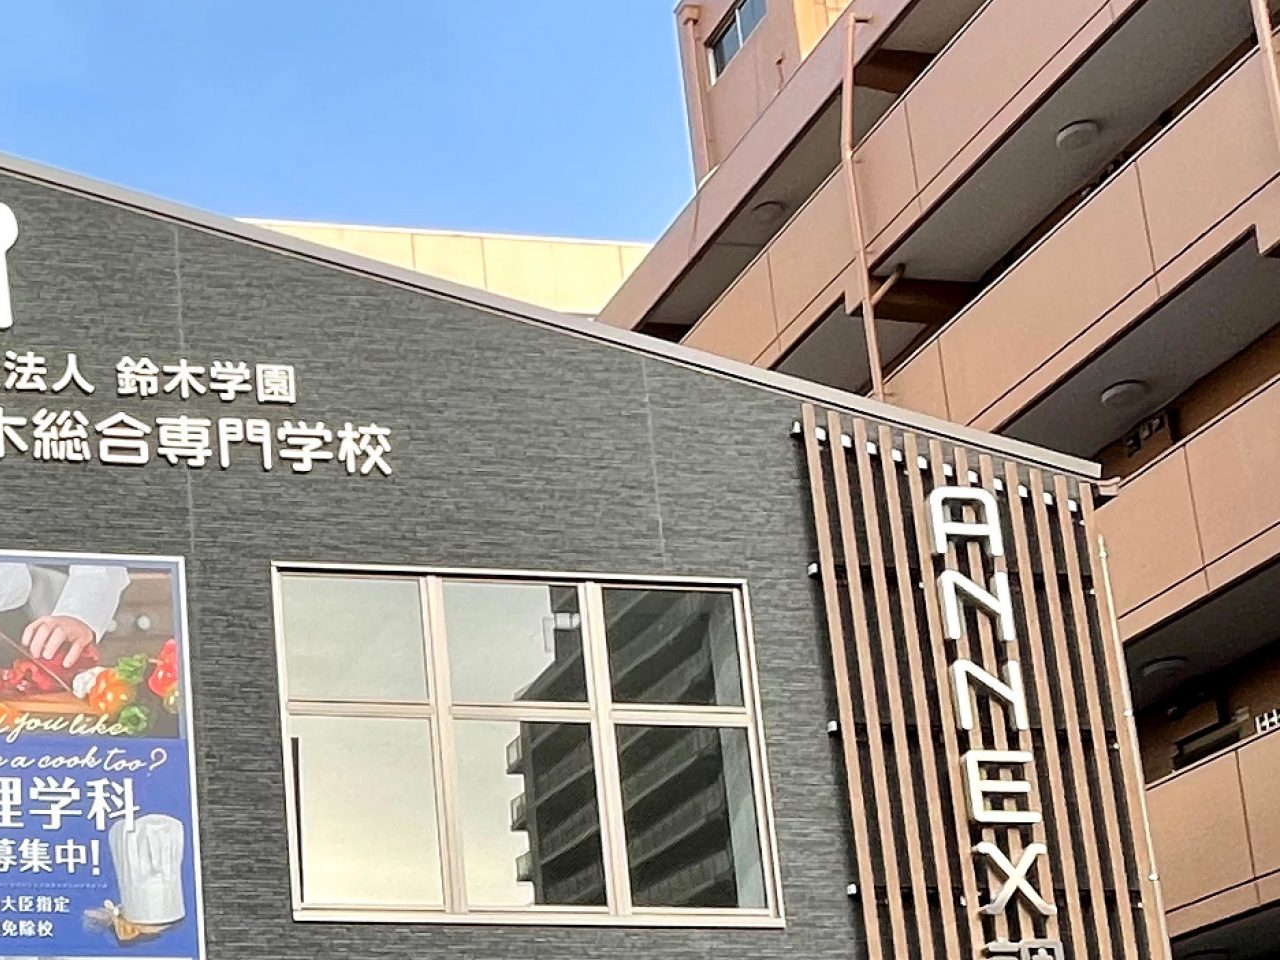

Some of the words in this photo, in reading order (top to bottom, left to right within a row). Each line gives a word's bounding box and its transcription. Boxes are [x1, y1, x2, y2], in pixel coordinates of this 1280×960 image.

[115, 355, 298, 405] 鈴木学園
[928, 485, 1058, 916] ANNEX
[5, 712, 69, 743] you
[10, 756, 36, 768] a
[37, 745, 102, 769] cook
